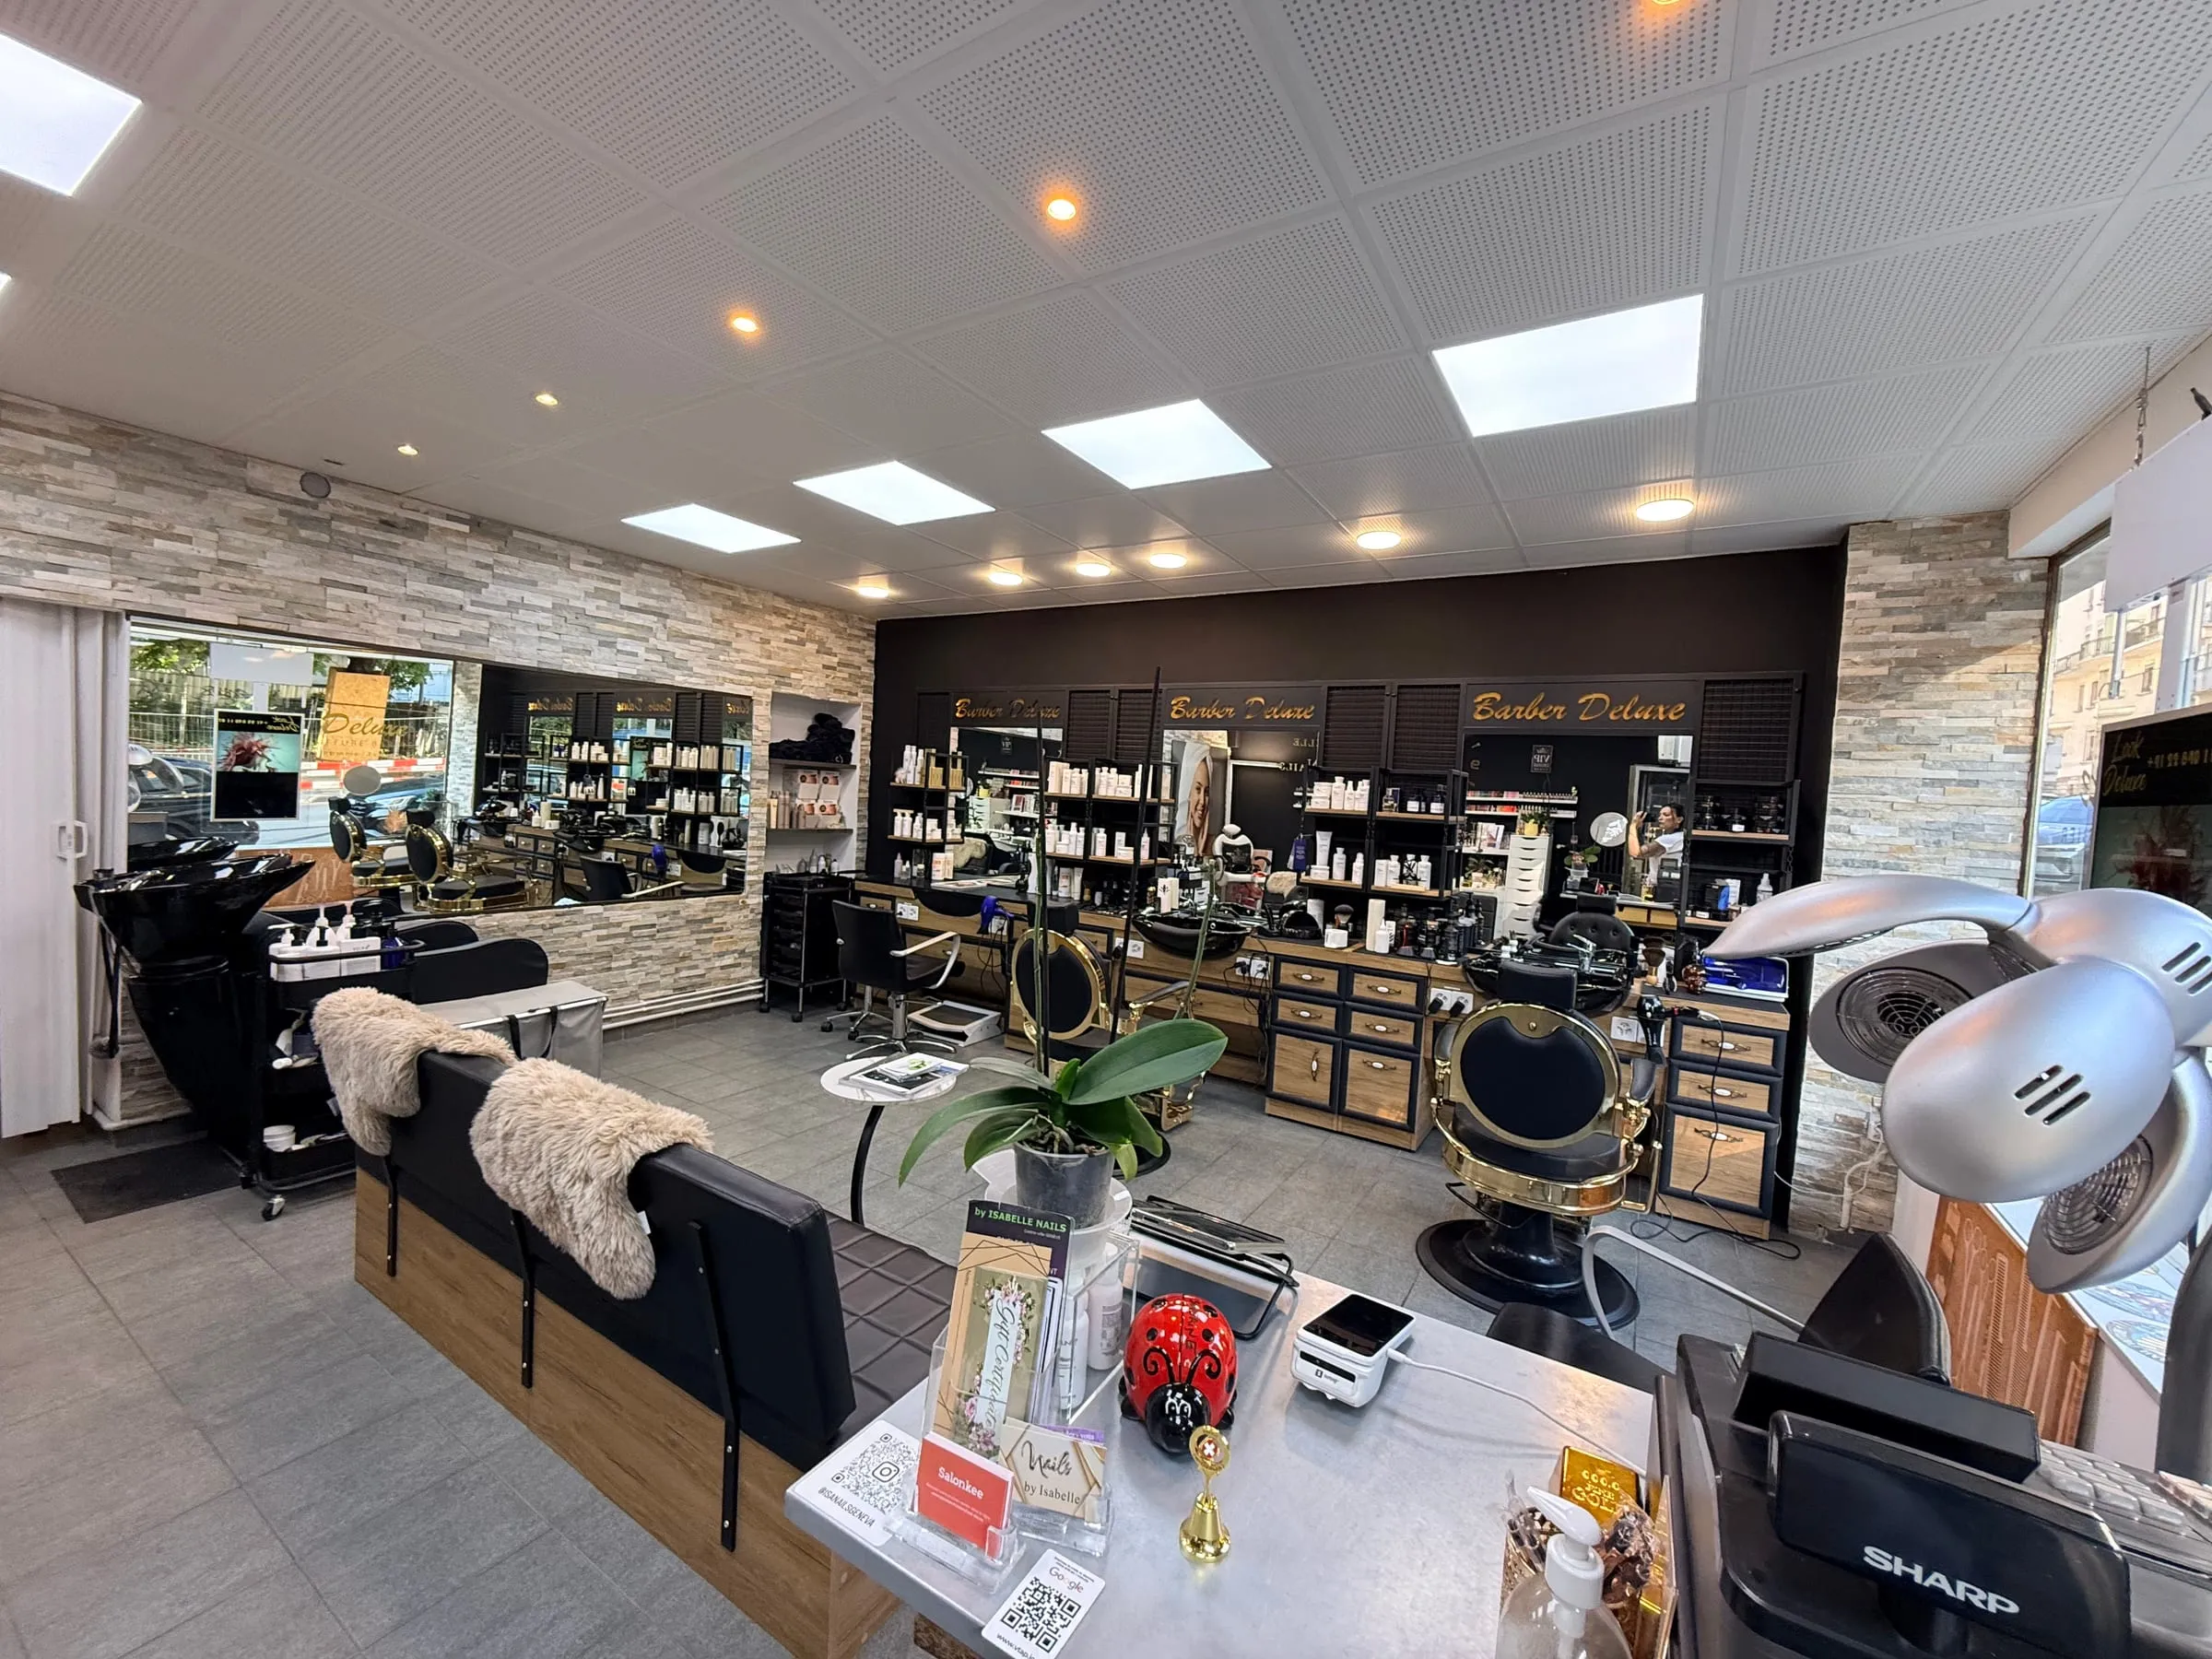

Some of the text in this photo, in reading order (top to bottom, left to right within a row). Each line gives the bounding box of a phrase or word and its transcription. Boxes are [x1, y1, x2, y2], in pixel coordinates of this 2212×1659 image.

[1171, 695, 1315, 721] Barber Deluxe
[1473, 691, 1686, 722] Barber Deluxe
[322, 712, 408, 736] Deluxe
[974, 1206, 1067, 1232] by ISABELLE NAILS
[994, 1298, 1016, 1345] Gift
[1021, 1440, 1073, 1478] Nails
[937, 1466, 984, 1500] Salonkee
[1023, 1480, 1081, 1505] by Isabelle
[1049, 1566, 1084, 1593] Google
[1863, 1545, 2020, 1614] SHARP
